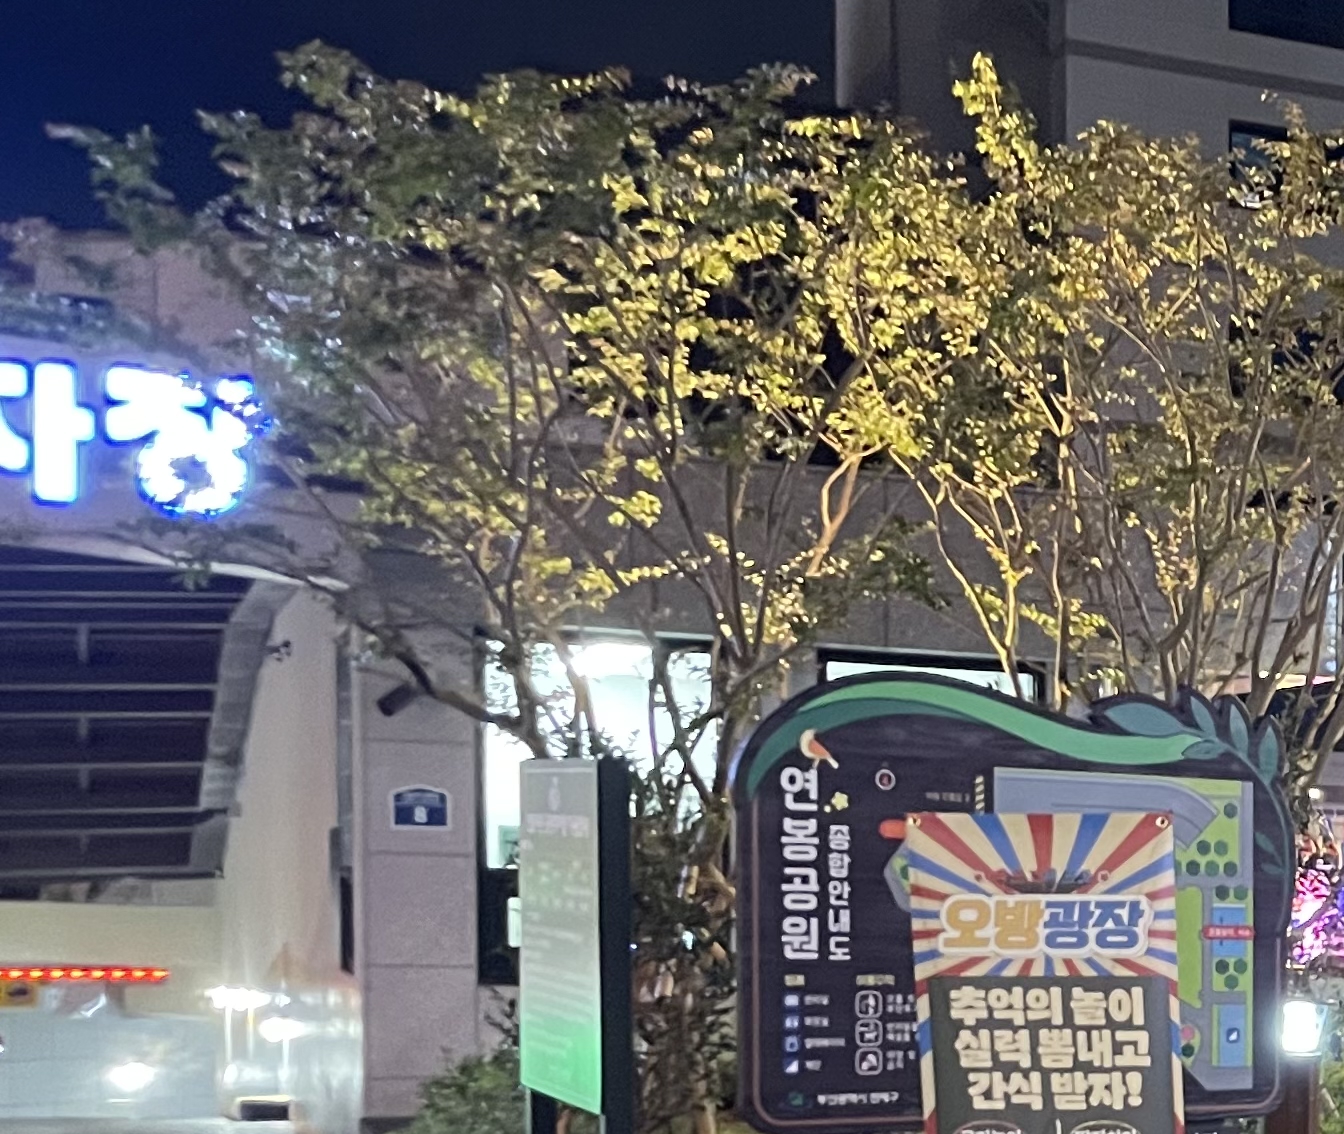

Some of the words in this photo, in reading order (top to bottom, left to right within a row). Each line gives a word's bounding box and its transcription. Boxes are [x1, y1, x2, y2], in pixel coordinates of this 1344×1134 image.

[780, 766, 820, 960] 연봉공원
[828, 824, 851, 961] 종합안내도
[944, 899, 1144, 950] 오방광장
[950, 986, 1062, 1025] 추억의
[1070, 986, 1145, 1025] 놀이
[955, 1029, 1032, 1067] 실력
[1037, 1029, 1151, 1067] 뽐내고
[967, 1071, 1043, 1110] 간식
[1050, 1071, 1143, 1110] 받자!
